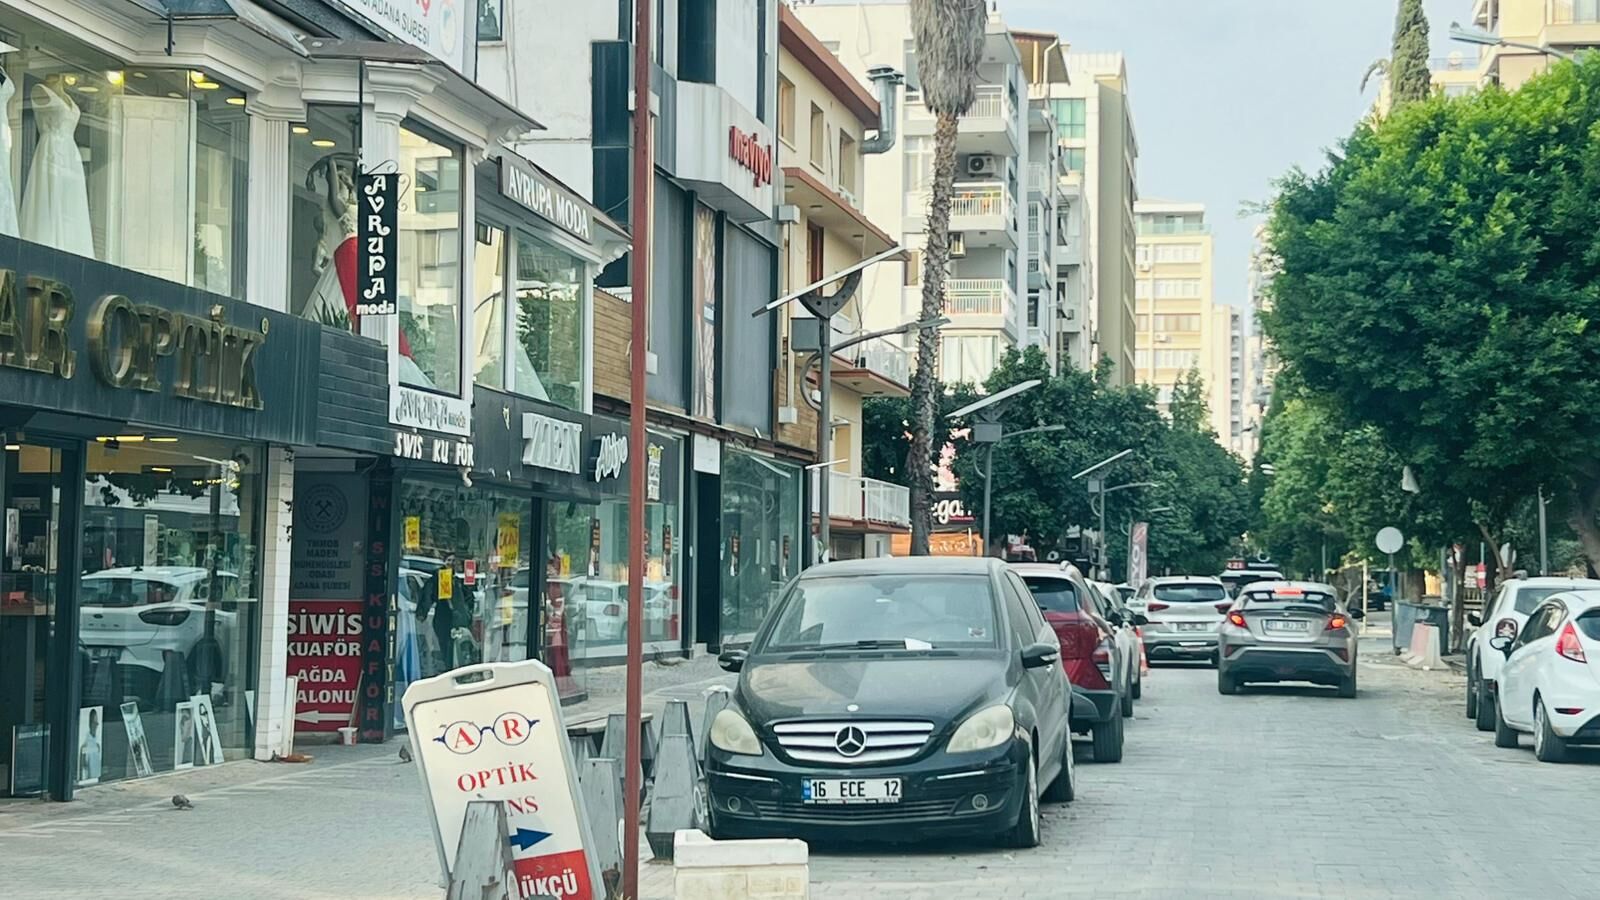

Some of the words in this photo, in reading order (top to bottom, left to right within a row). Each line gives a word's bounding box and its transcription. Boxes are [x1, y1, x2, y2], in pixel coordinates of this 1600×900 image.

[508, 165, 554, 220] AVRUPA
[555, 193, 589, 239] MODA
[364, 175, 390, 299] AVRUPA
[356, 300, 395, 315] moda
[88, 294, 266, 411] OPTİK
[432, 439, 449, 464] KU
[454, 437, 475, 467] FÖR
[306, 549, 338, 558] MADEN
[308, 570, 335, 578] ODASI
[286, 608, 363, 635] SİWİS
[286, 638, 361, 656] KUAFÖR
[297, 665, 346, 682] AĞDA
[295, 689, 356, 704] ALONU
[456, 761, 539, 793] OPTİK
[812, 781, 827, 797] 16
[840, 781, 866, 797] ECE
[884, 780, 899, 797] 12
[506, 795, 539, 817] NS
